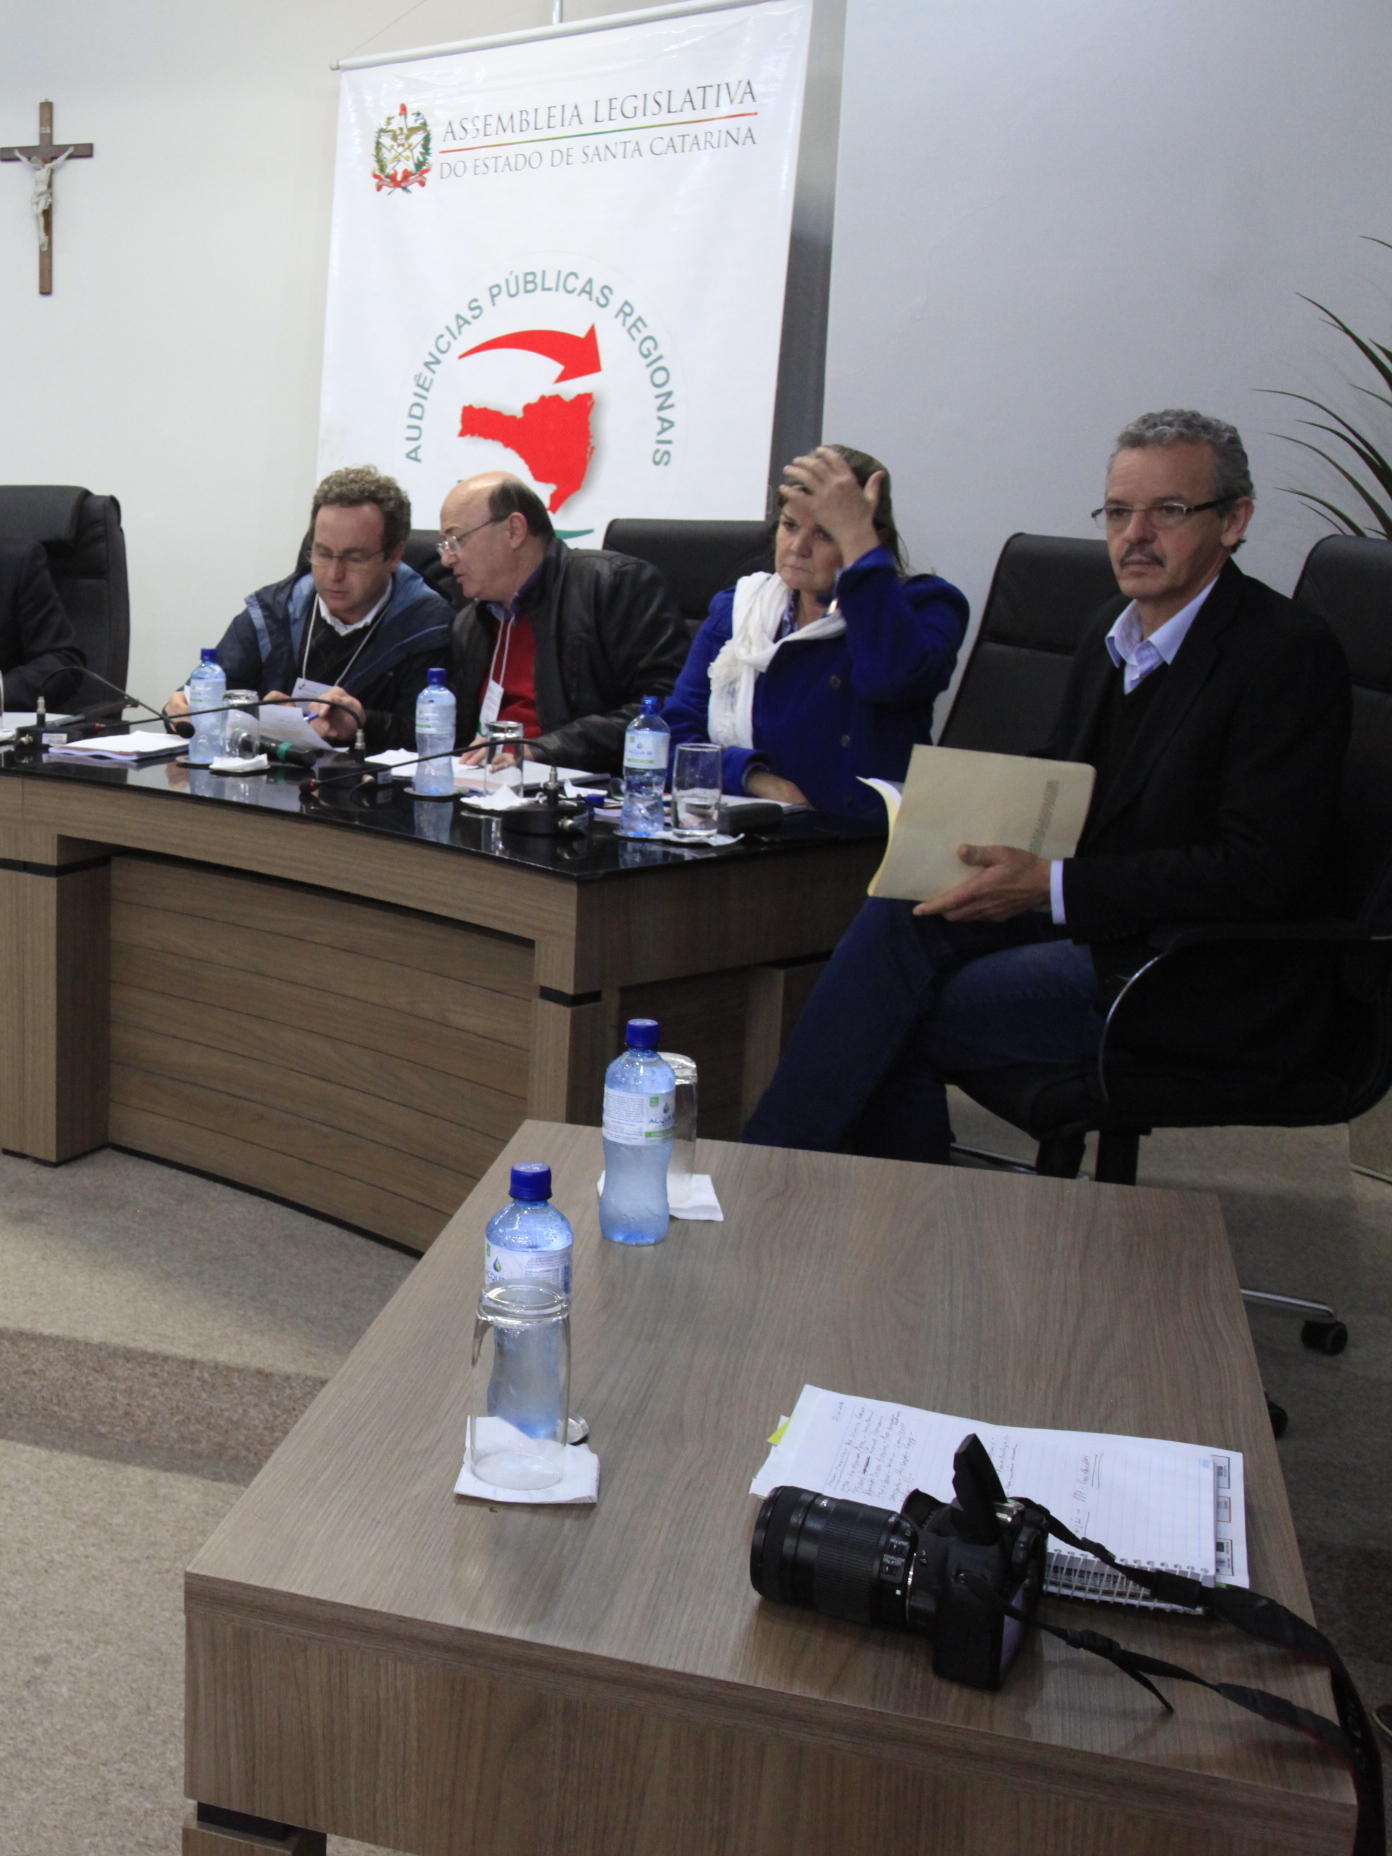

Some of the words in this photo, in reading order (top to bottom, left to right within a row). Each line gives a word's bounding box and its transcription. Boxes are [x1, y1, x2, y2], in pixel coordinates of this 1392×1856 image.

[442, 102, 584, 142] ASSEMBLEIA
[593, 78, 758, 124] LEGISLATIVA
[439, 159, 467, 179] DO
[473, 150, 543, 176] ESTADO
[550, 147, 575, 168] DE
[581, 139, 643, 164] SANTA
[649, 126, 758, 156] CATARINA
[405, 298, 484, 464] AUDIÊNCIAS
[488, 270, 614, 308] PÚBLICAS
[614, 299, 675, 467] REGIONAIS
